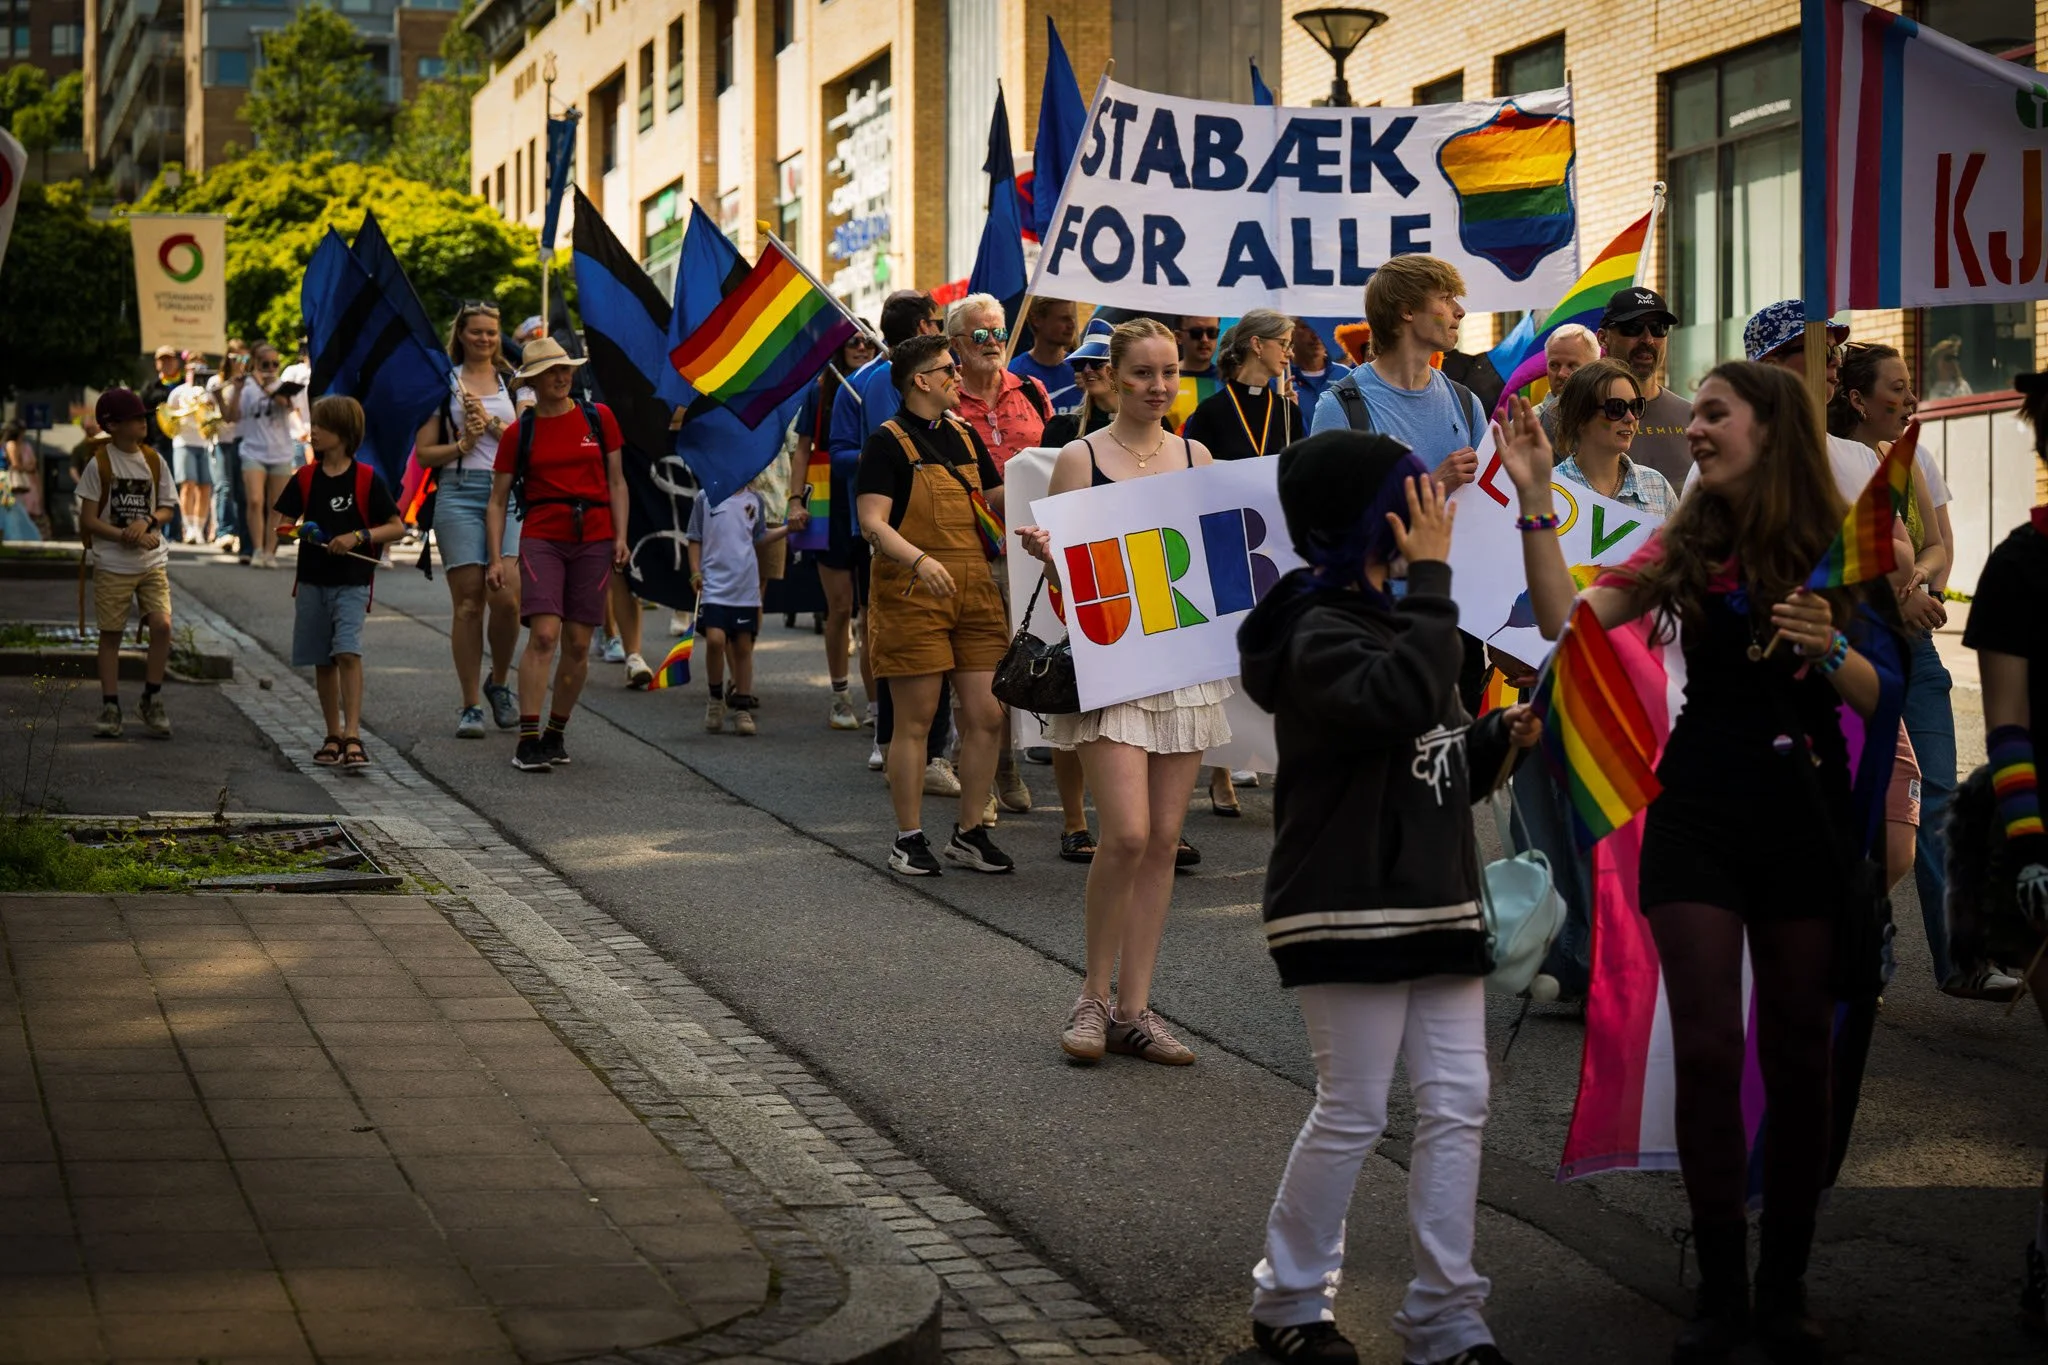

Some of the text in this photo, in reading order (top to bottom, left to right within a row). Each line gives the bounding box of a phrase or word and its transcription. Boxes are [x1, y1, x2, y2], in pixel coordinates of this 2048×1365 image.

[1081, 97, 1420, 198] STABÆK
[1047, 205, 1432, 289] FOR ALLE
[1934, 149, 2048, 288] KJ
[120, 494, 145, 506] VANS
